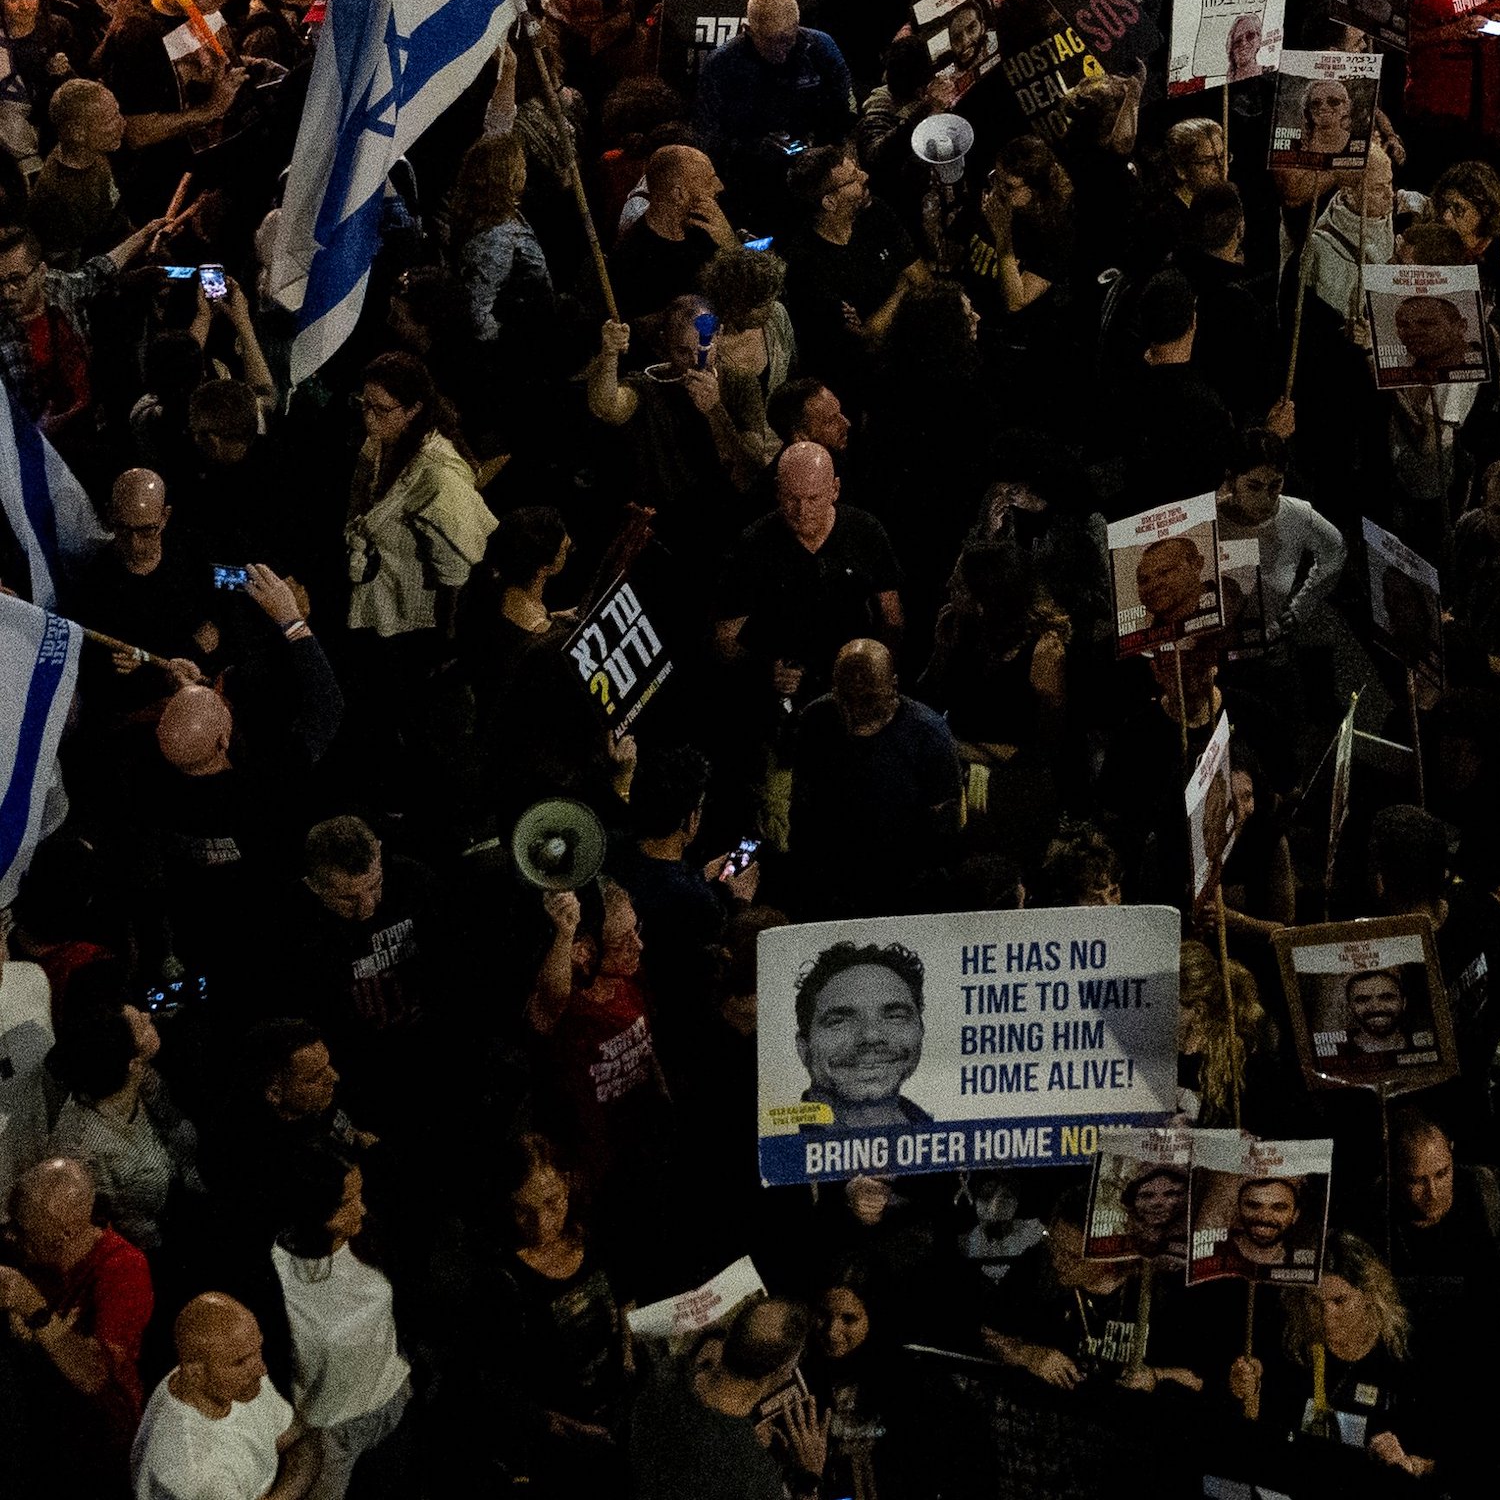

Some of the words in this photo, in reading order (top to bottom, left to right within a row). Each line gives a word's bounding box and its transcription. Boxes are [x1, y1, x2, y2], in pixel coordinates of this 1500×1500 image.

[1003, 25, 1087, 86] HOSTAG
[1014, 70, 1073, 117] DEAL
[1273, 139, 1292, 151] HER
[1274, 127, 1302, 140] BRING
[1378, 344, 1408, 357] BRING
[1379, 356, 1399, 369] HIM
[600, 582, 645, 634] עד
[1117, 605, 1147, 622] BRING
[1118, 620, 1137, 638] HIM
[568, 626, 611, 682] לא
[962, 944, 998, 975] HE
[1006, 941, 1061, 973] HAS
[1069, 939, 1107, 970] NO
[962, 981, 1028, 1015] TIME
[1034, 980, 1069, 1012] TO
[1077, 977, 1152, 1011] WAIT.
[961, 1022, 1047, 1057] BRING
[1053, 1019, 1105, 1051] HIM
[960, 1063, 1042, 1097] HOME
[1046, 1058, 1134, 1093] ALIVE!
[806, 1132, 889, 1173] BRING
[897, 1129, 967, 1167] OFER
[974, 1126, 1053, 1162] HOME
[1059, 1124, 1112, 1158] NO
[1194, 1228, 1228, 1244] BRING
